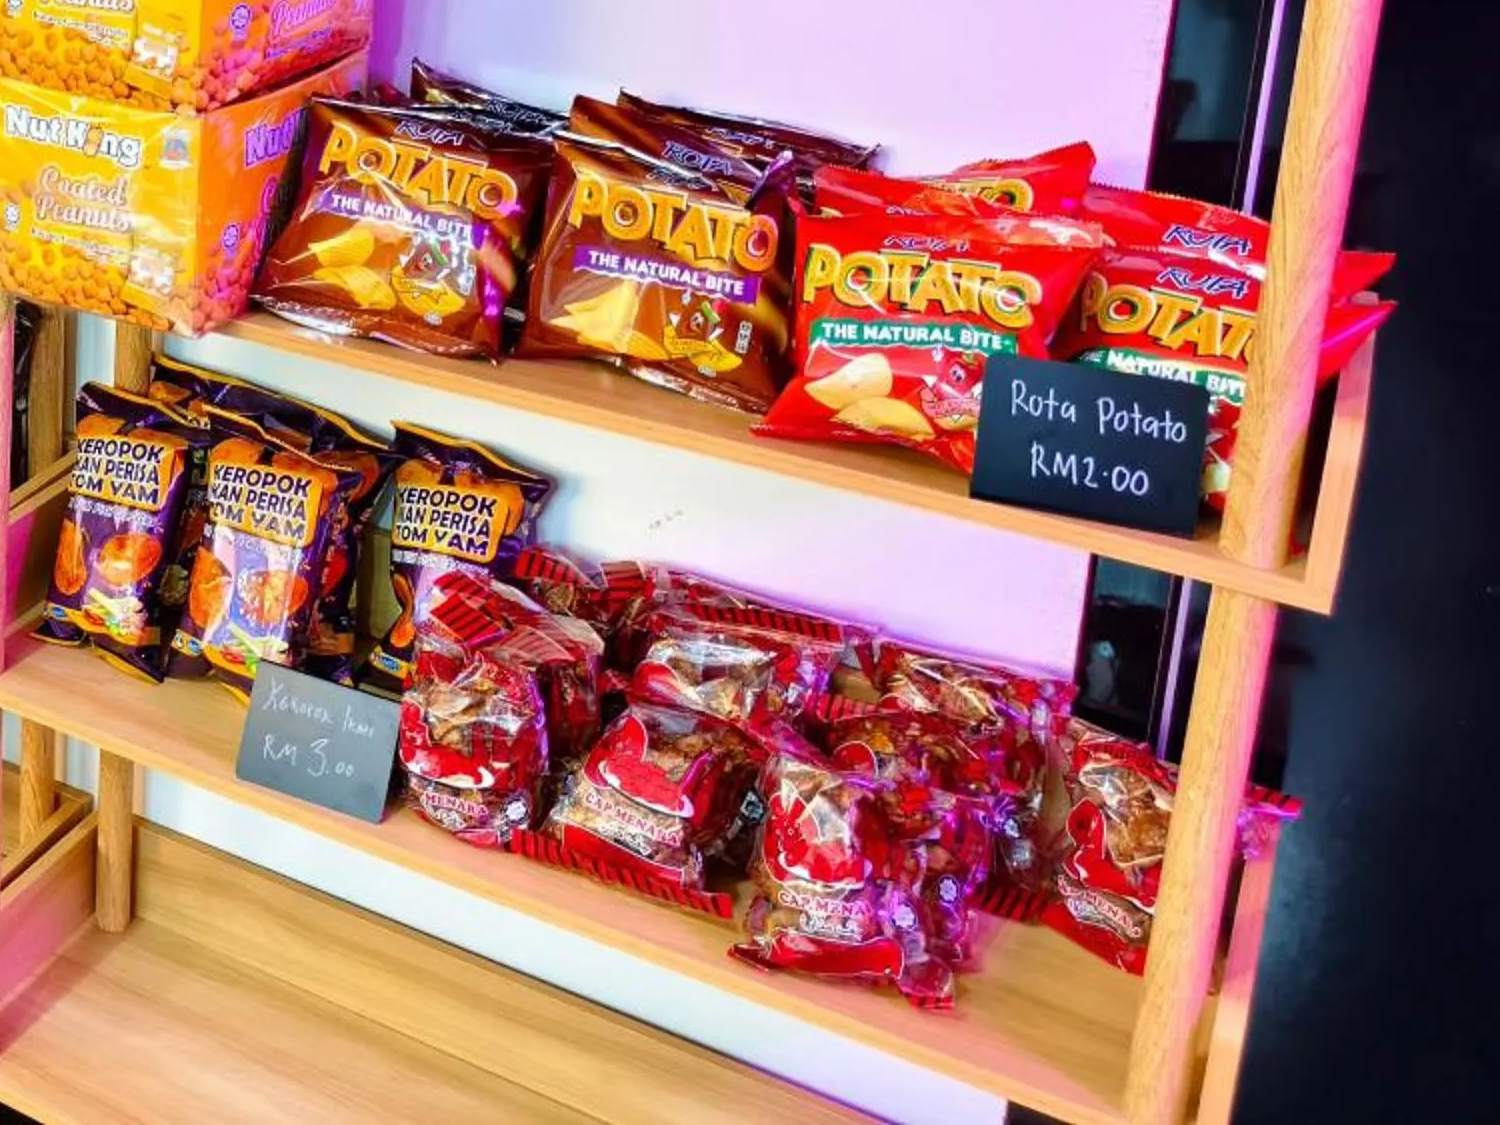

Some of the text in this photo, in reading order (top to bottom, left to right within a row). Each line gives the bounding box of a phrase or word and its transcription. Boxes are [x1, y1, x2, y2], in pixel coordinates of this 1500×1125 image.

[40, 164, 130, 207] Coated
[320, 120, 519, 220] POTATO
[34, 193, 135, 234] Peanuts
[331, 193, 473, 241] THE NATURAL BITE
[568, 170, 779, 273] POTATO
[588, 250, 746, 296] THE NATURAL BITE
[802, 243, 1043, 331] POTATO
[1079, 271, 1257, 361] POTAT
[821, 321, 1004, 350] THE NATURAL BITE
[1106, 349, 1199, 384] NATURAL
[1011, 382, 1187, 443] Rota Potato
[104, 459, 160, 485] PERISA
[213, 464, 313, 498] KEROPOK
[111, 479, 160, 505] YAM
[245, 488, 306, 521] PERISA
[251, 509, 306, 540] YAM
[396, 524, 489, 556] TOM YAM
[429, 508, 491, 539] PERISA
